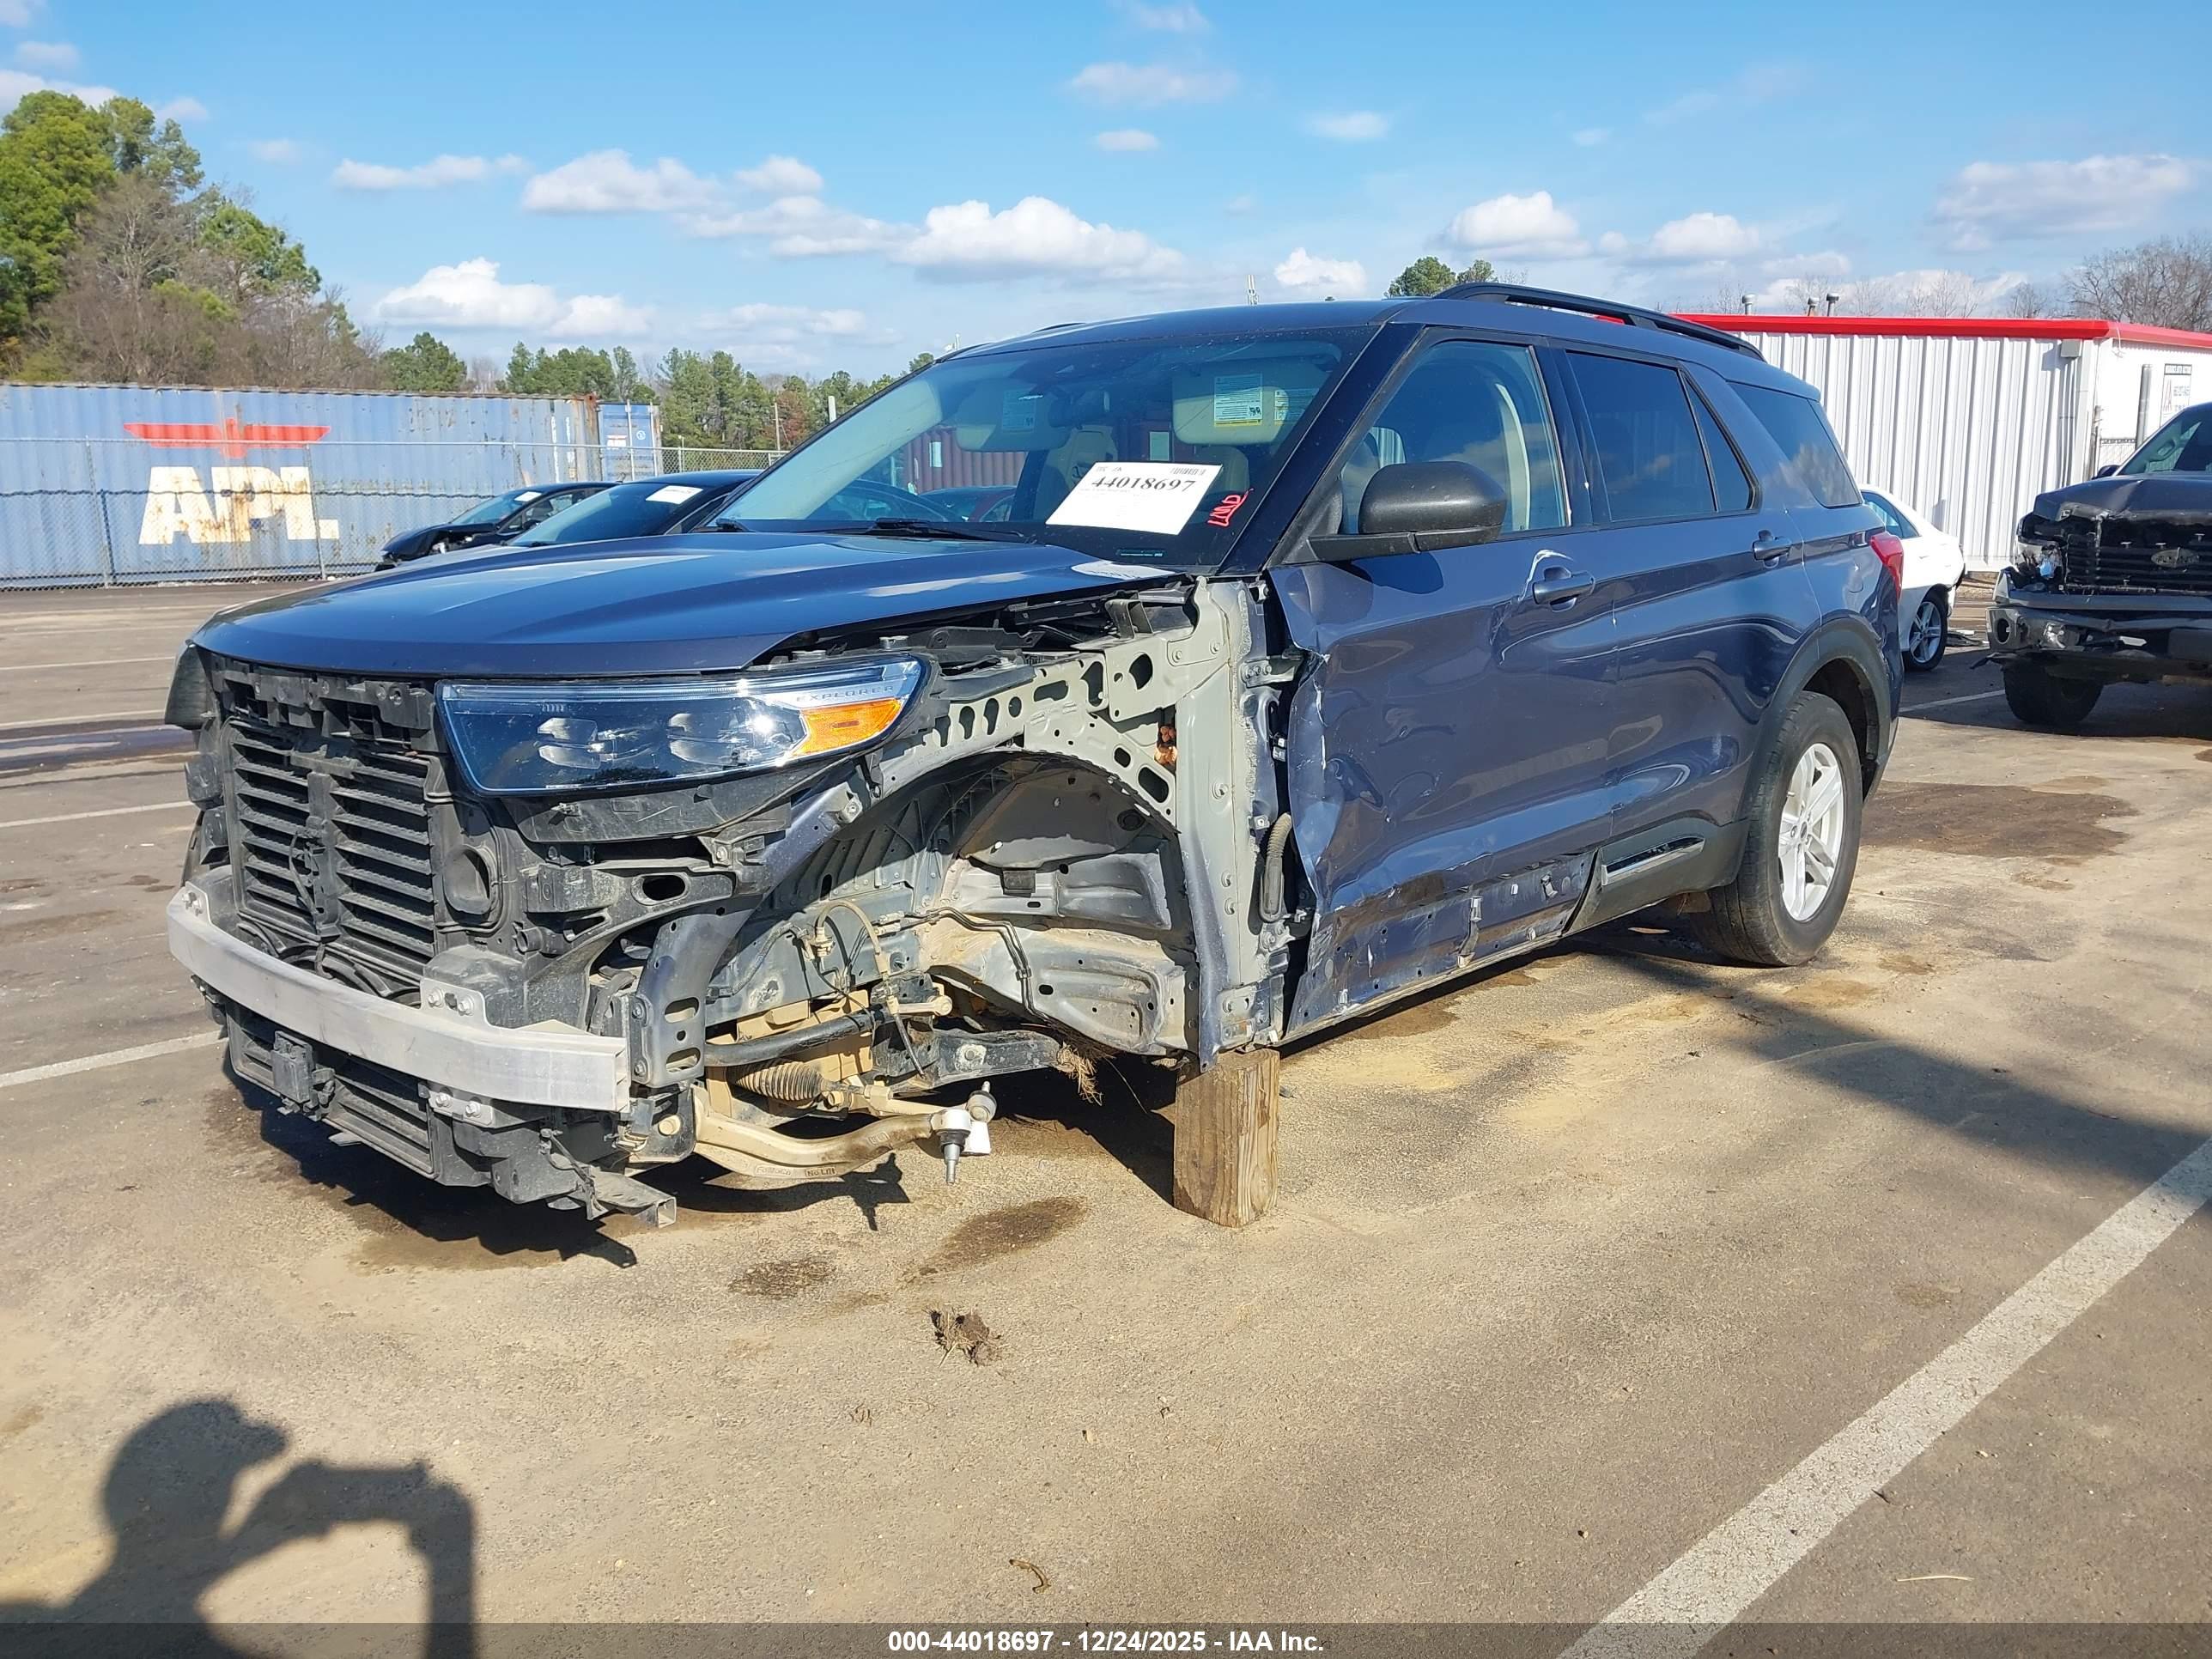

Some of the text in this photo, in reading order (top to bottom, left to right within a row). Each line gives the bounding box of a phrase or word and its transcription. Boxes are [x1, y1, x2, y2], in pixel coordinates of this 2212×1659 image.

[1091, 476, 1196, 492] 44018697
[138, 466, 339, 545] APL
[796, 686, 894, 702] EXPLORER
